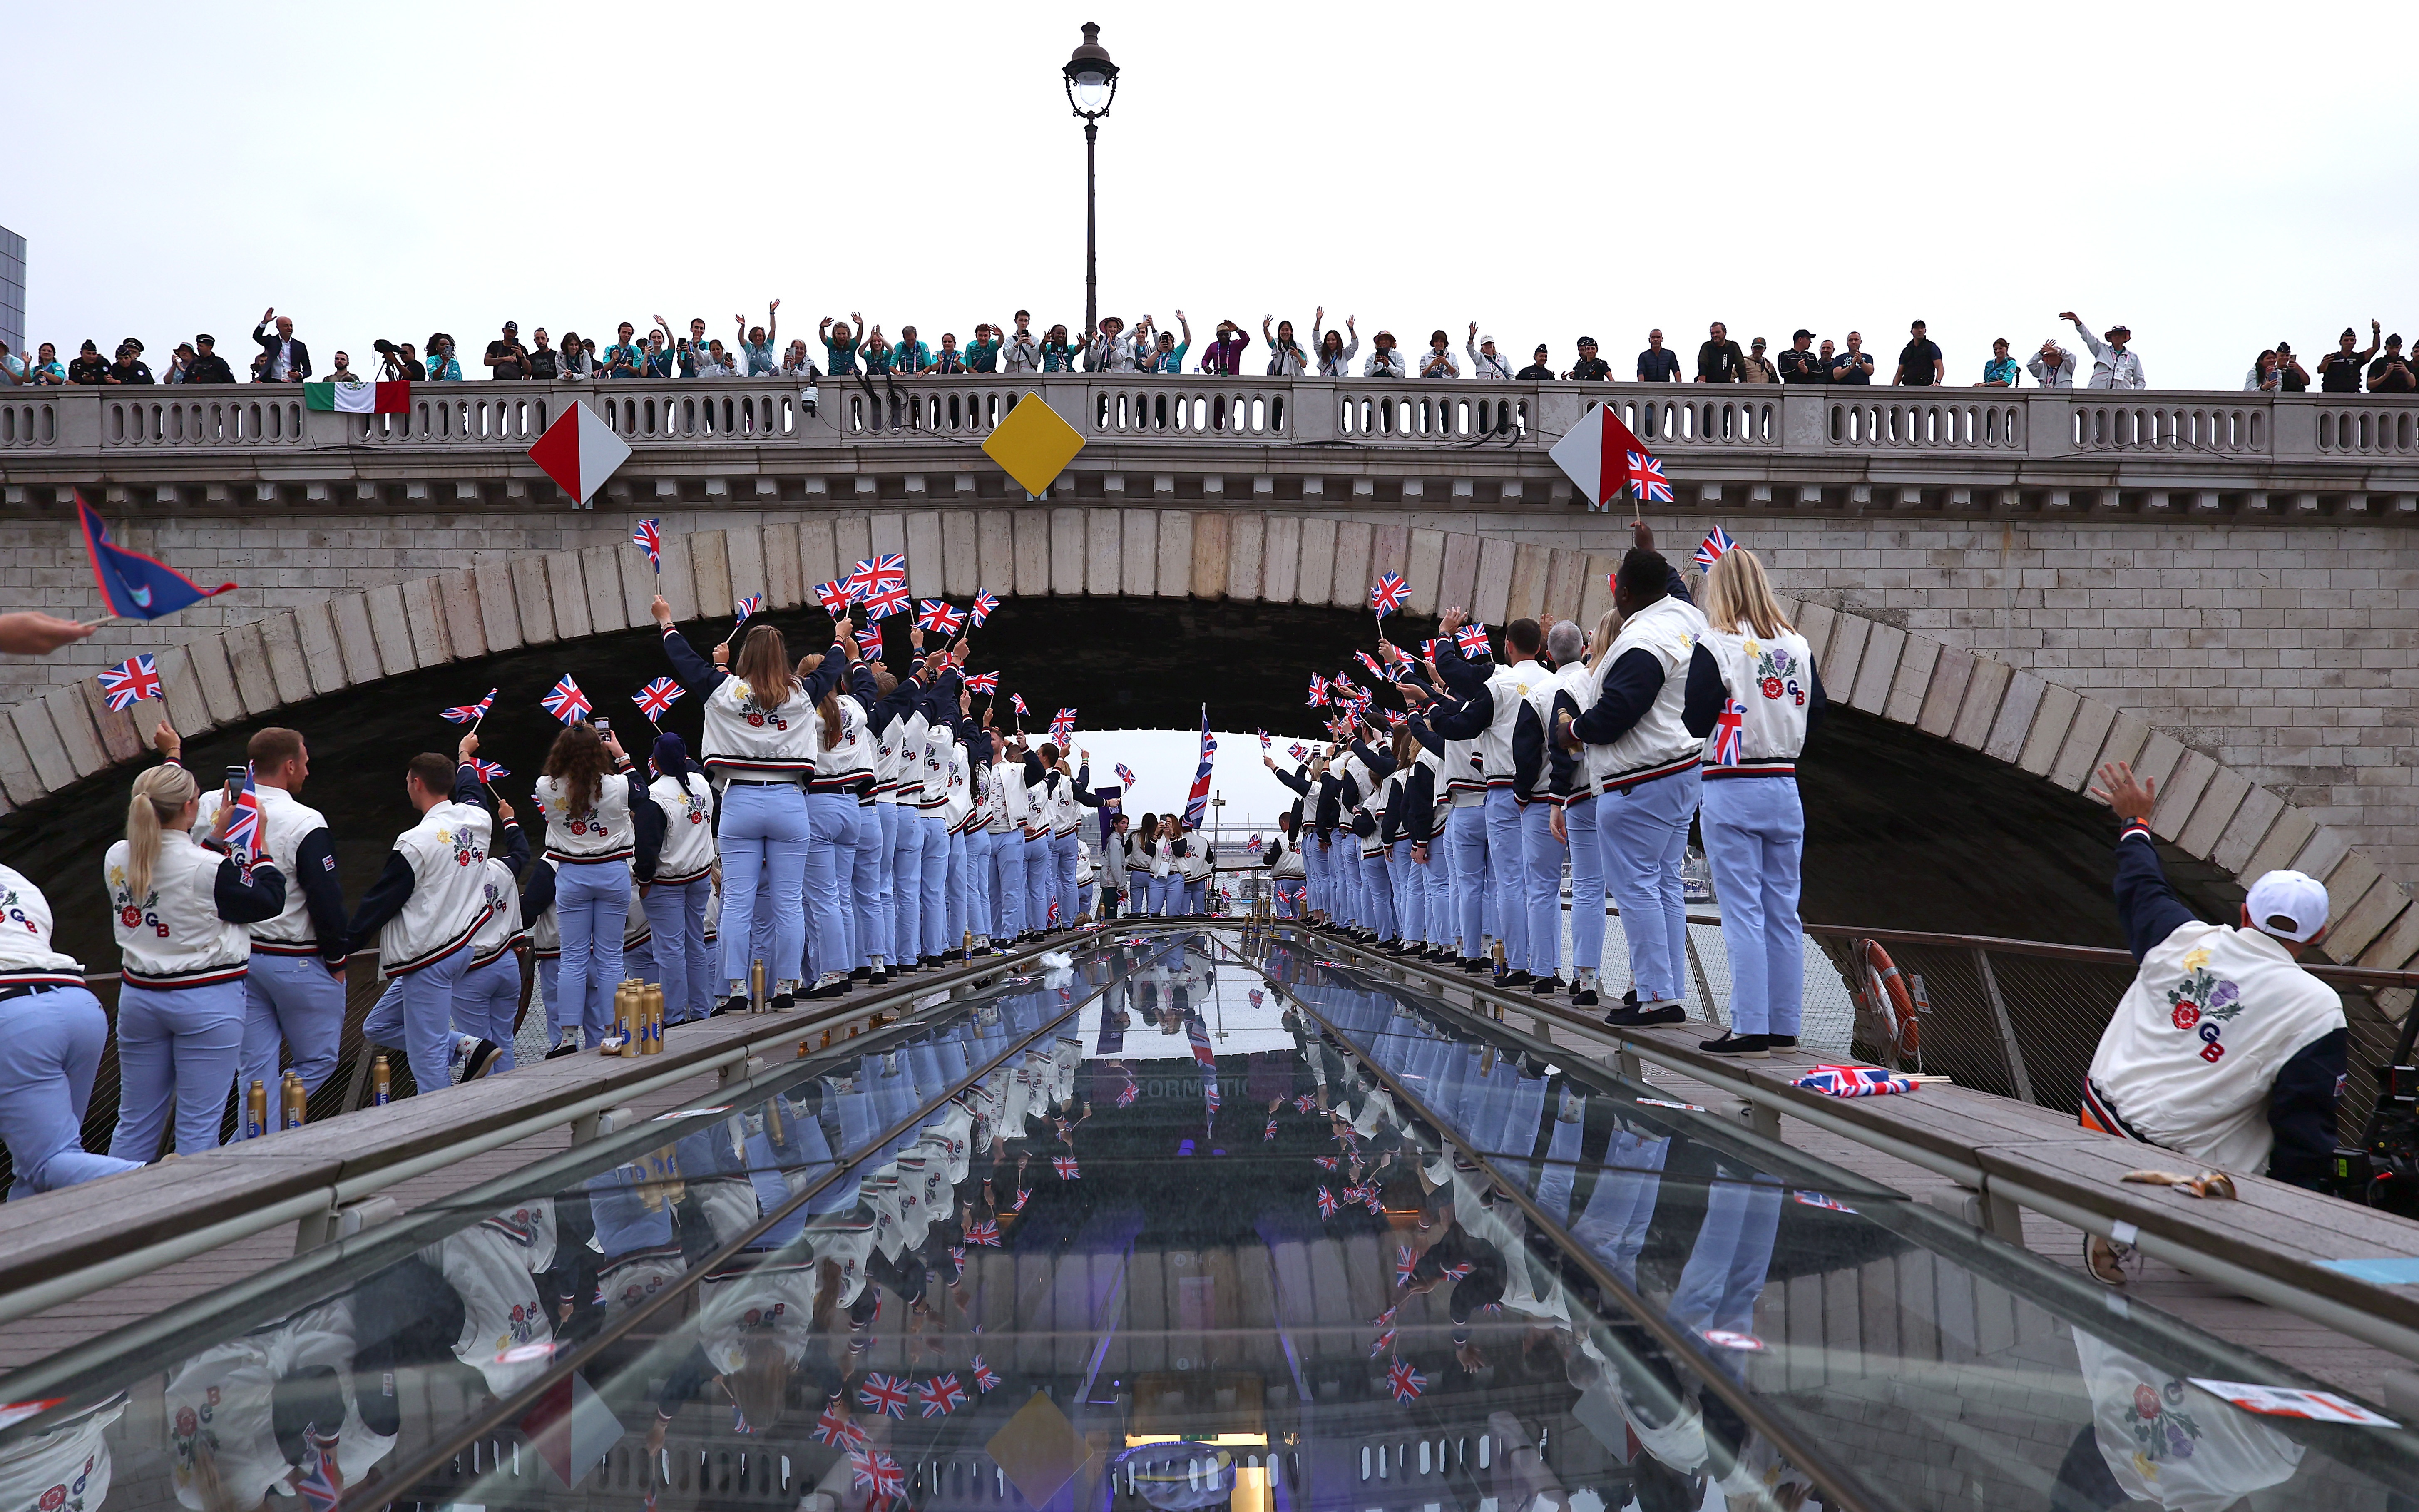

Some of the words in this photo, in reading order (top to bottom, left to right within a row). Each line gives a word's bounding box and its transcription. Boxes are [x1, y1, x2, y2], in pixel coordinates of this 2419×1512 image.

[1787, 680, 1805, 706] GB
[768, 714, 788, 730] GB
[845, 729, 855, 745] GB
[879, 746, 891, 757] GB
[902, 750, 916, 761] GB
[928, 758, 940, 771] GB
[955, 775, 962, 786] GB
[1032, 804, 1041, 814] GB
[703, 810, 710, 824] GB
[590, 822, 608, 837] GB
[472, 847, 483, 863] GB
[496, 899, 507, 913] GB
[11, 908, 38, 933] GB
[145, 912, 170, 937] GB
[2198, 1022, 2225, 1063] GB
